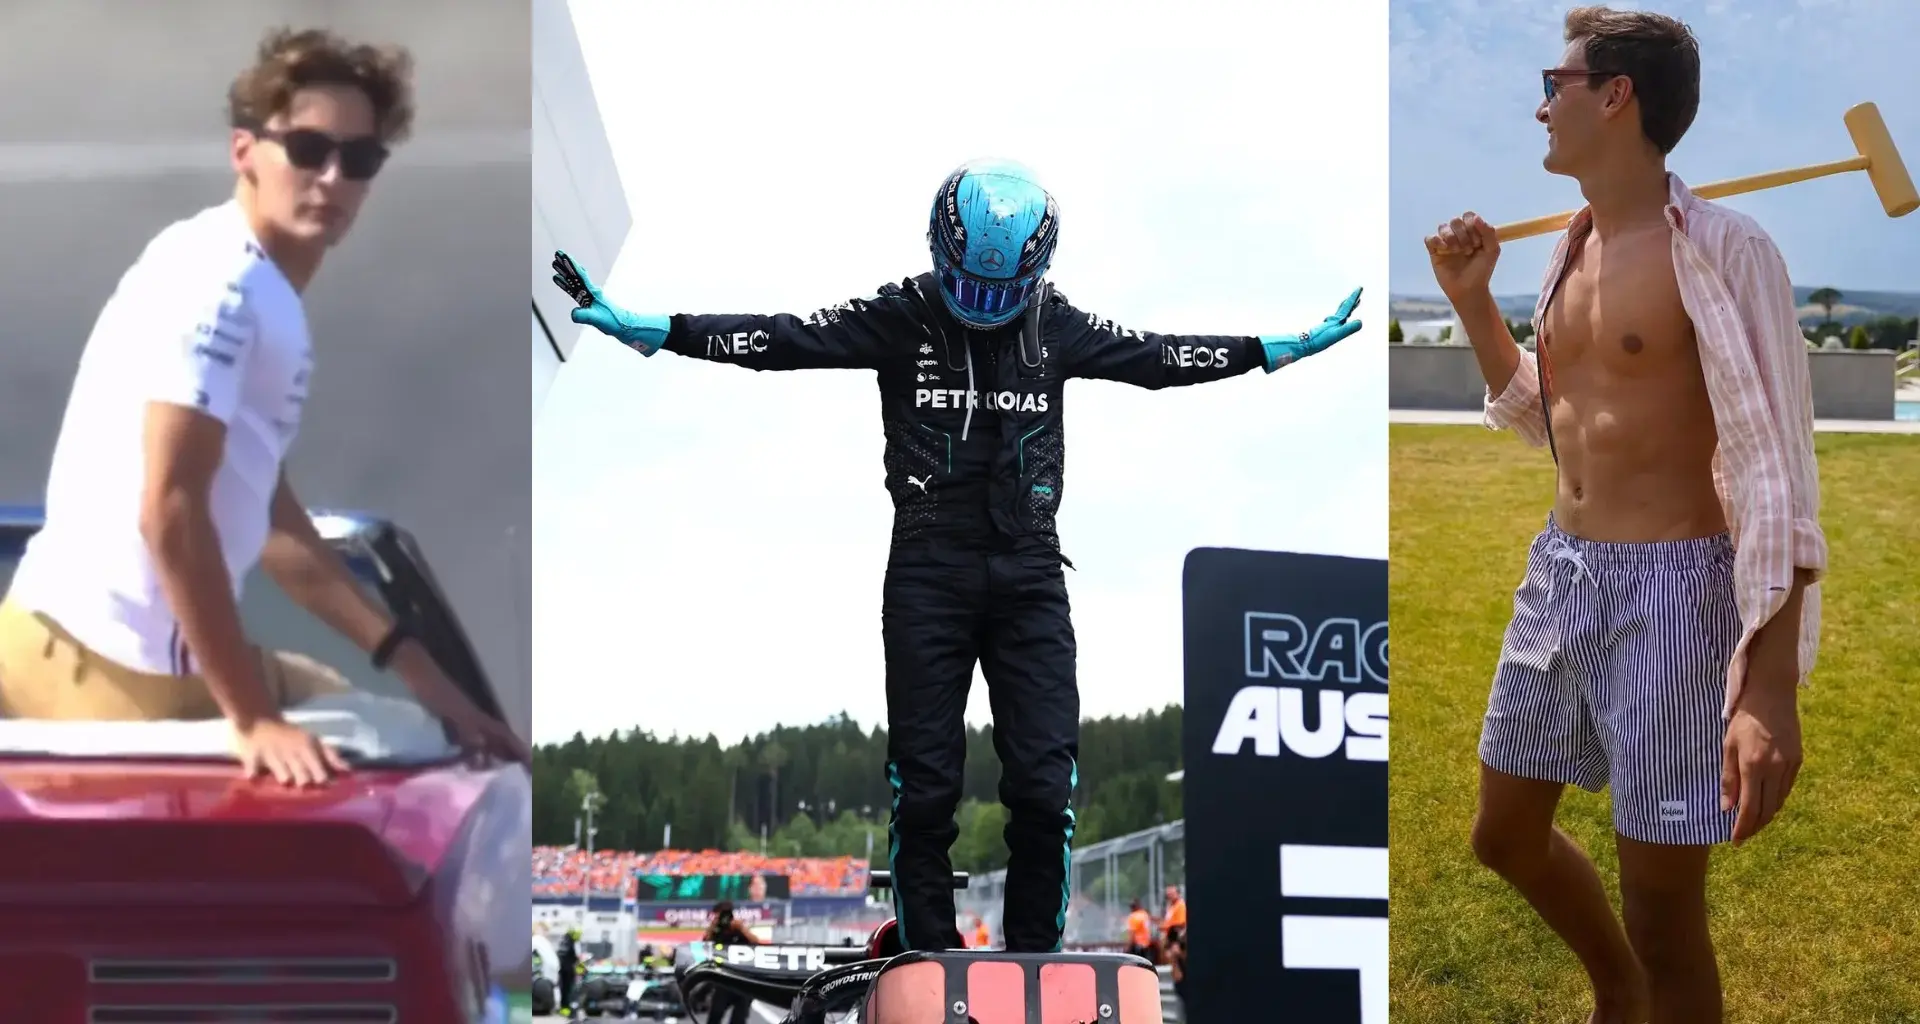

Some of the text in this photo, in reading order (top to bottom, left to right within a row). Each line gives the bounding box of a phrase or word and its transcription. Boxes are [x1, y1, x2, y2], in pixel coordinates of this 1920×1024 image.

[946, 175, 961, 224] SOLERA
[1161, 343, 1230, 369] INEOS
[915, 388, 1049, 412] PETROAS
[1211, 685, 1389, 762] AUS
